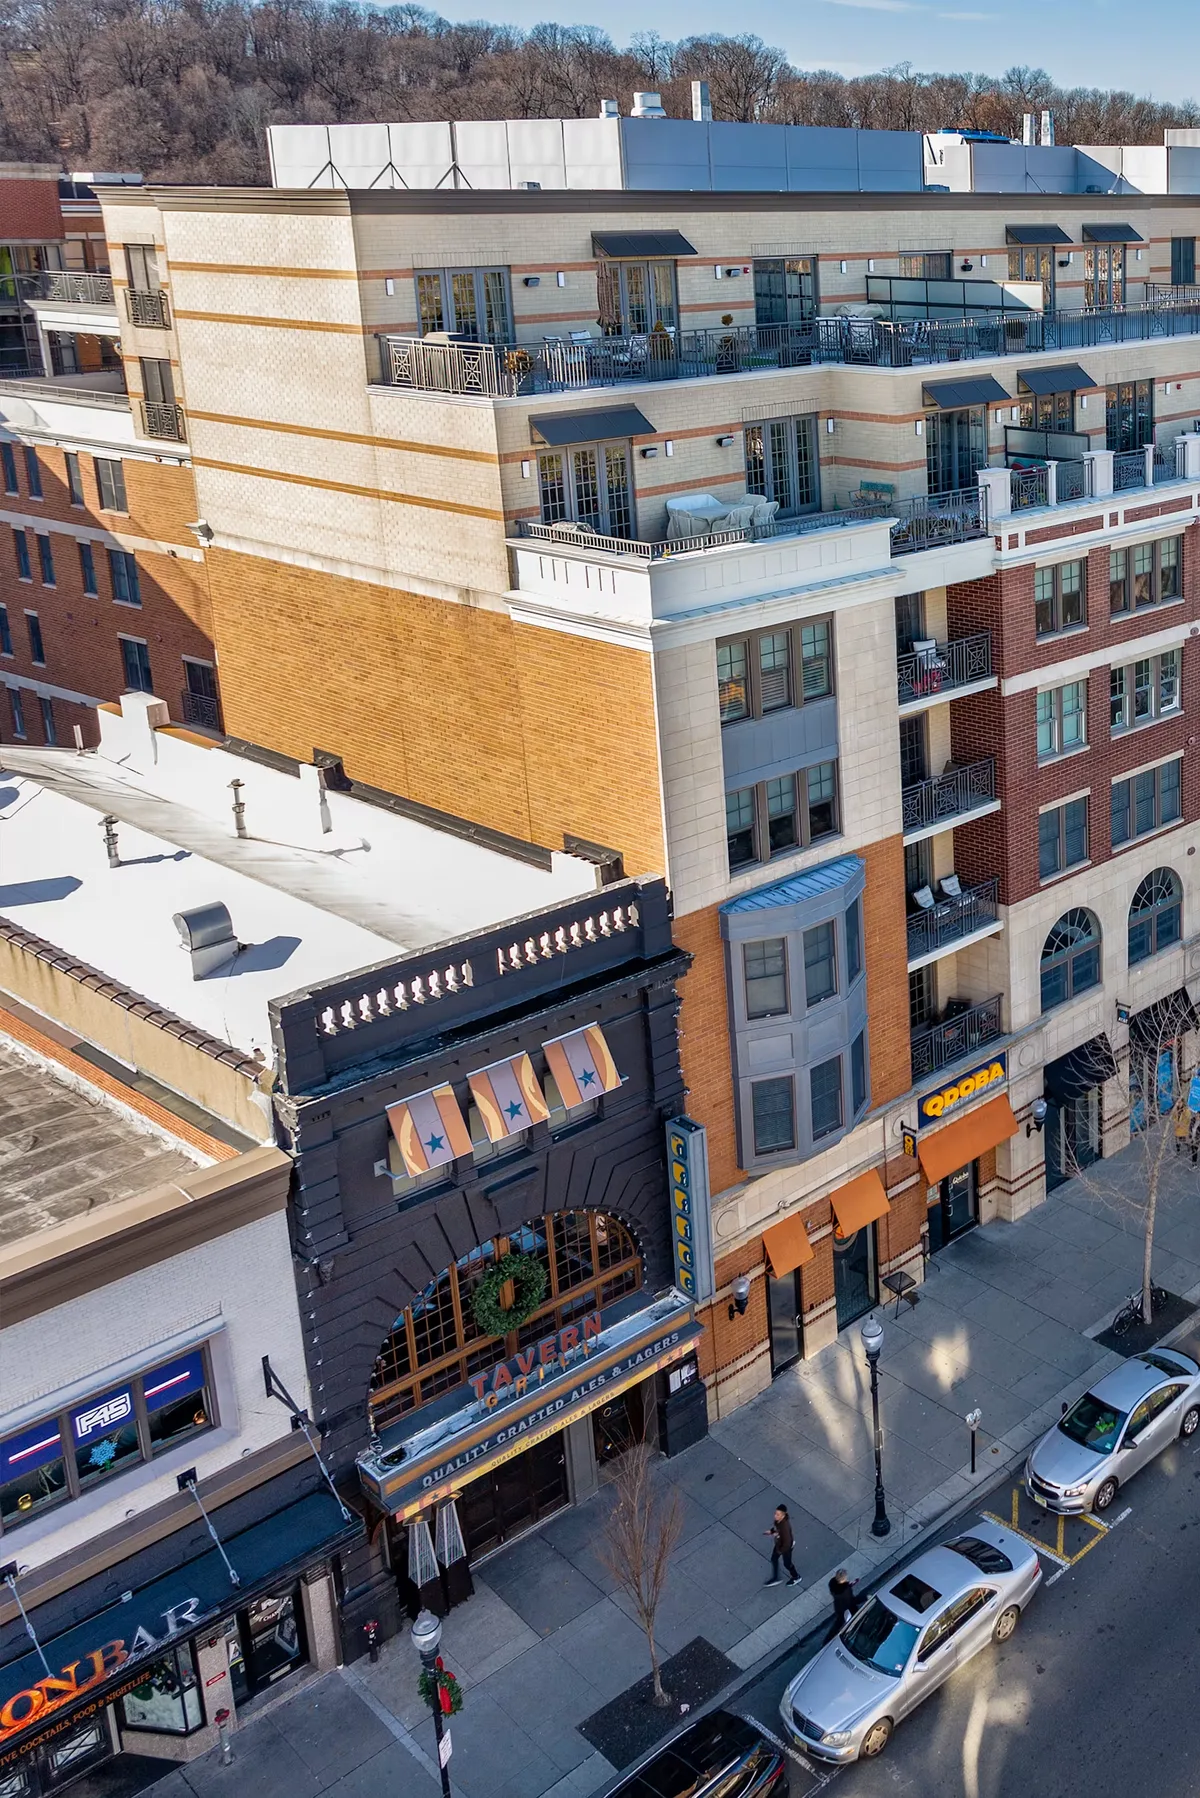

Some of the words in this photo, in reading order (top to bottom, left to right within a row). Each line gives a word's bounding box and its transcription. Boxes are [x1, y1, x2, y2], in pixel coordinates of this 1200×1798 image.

[922, 1061, 1005, 1117] QDOBA
[469, 1311, 602, 1400] TAVERN
[77, 1392, 131, 1438] F45
[422, 1441, 490, 1489] QUALITY
[496, 1399, 564, 1443] CRAFTED
[571, 1375, 606, 1401] ALES
[612, 1366, 622, 1378] &
[628, 1332, 680, 1367] LAGERS
[491, 1446, 523, 1468] QUALITY
[525, 1425, 558, 1448] CRAFTED
[560, 1411, 579, 1427] ALES
[587, 1391, 615, 1411] LAGERS
[0, 1659, 81, 1729] ON
[86, 1597, 203, 1680] BAR
[0, 1750, 18, 1767] IVE
[20, 1719, 71, 1755] COCKTAILS,
[72, 1703, 97, 1722] FOOD
[106, 1671, 152, 1705] NIGHTLIFE
